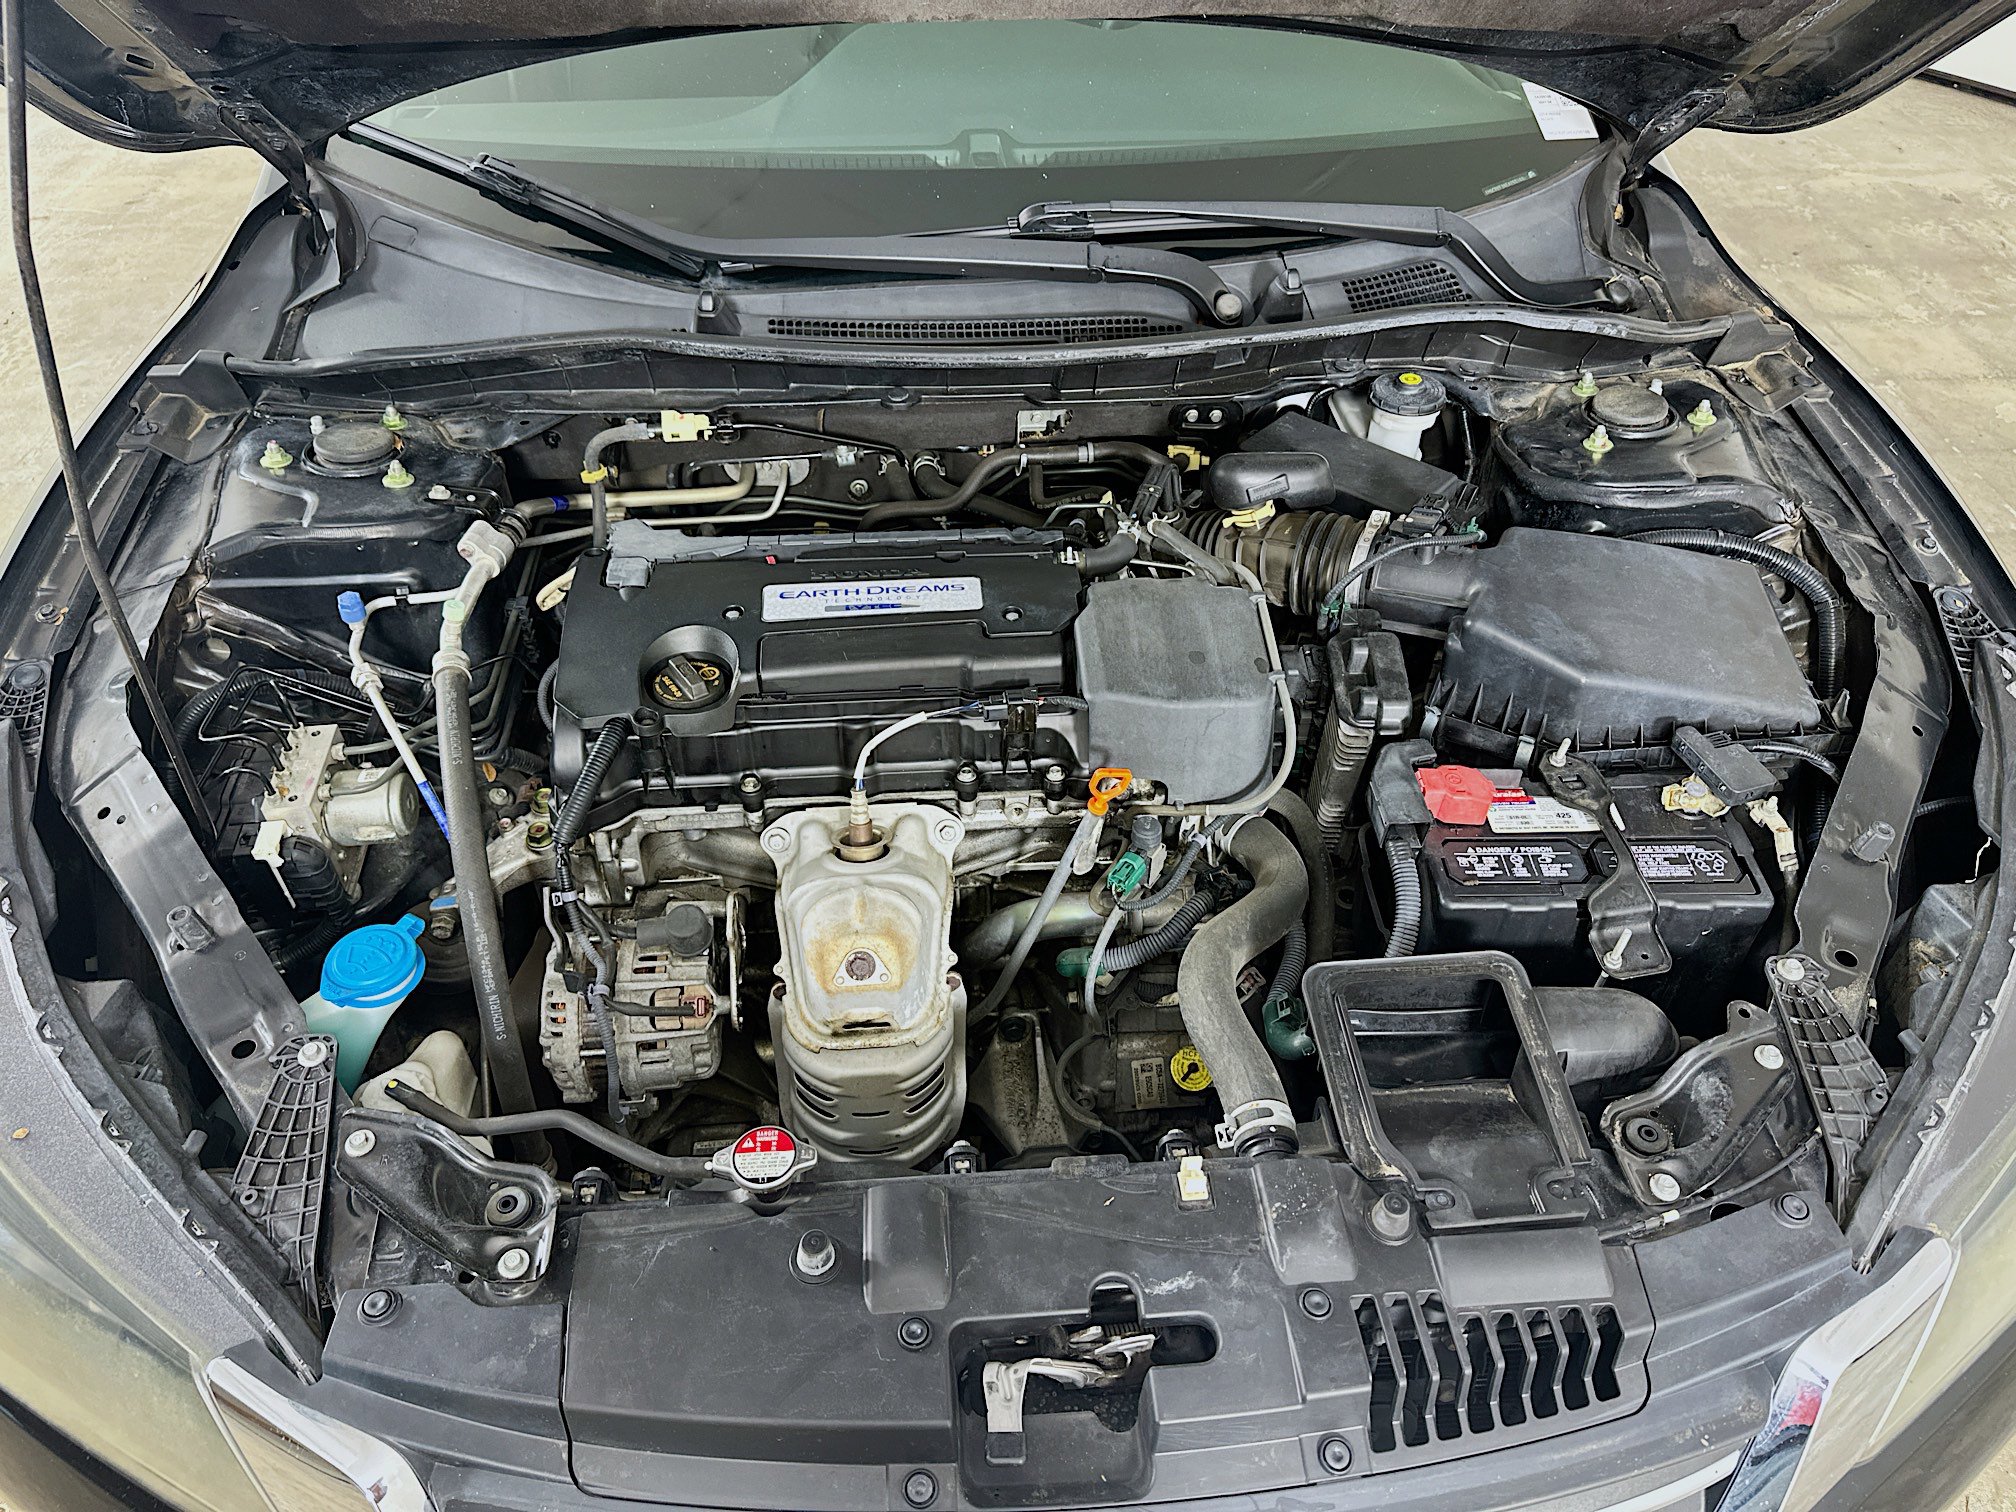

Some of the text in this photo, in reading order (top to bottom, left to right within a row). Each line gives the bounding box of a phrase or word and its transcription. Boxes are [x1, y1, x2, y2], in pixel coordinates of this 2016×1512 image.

[810, 568, 930, 580] HONDA
[779, 584, 966, 600] EARTH DREAMS
[824, 595, 922, 604] TECHNOLOGY
[1492, 790, 1527, 798] uralast
